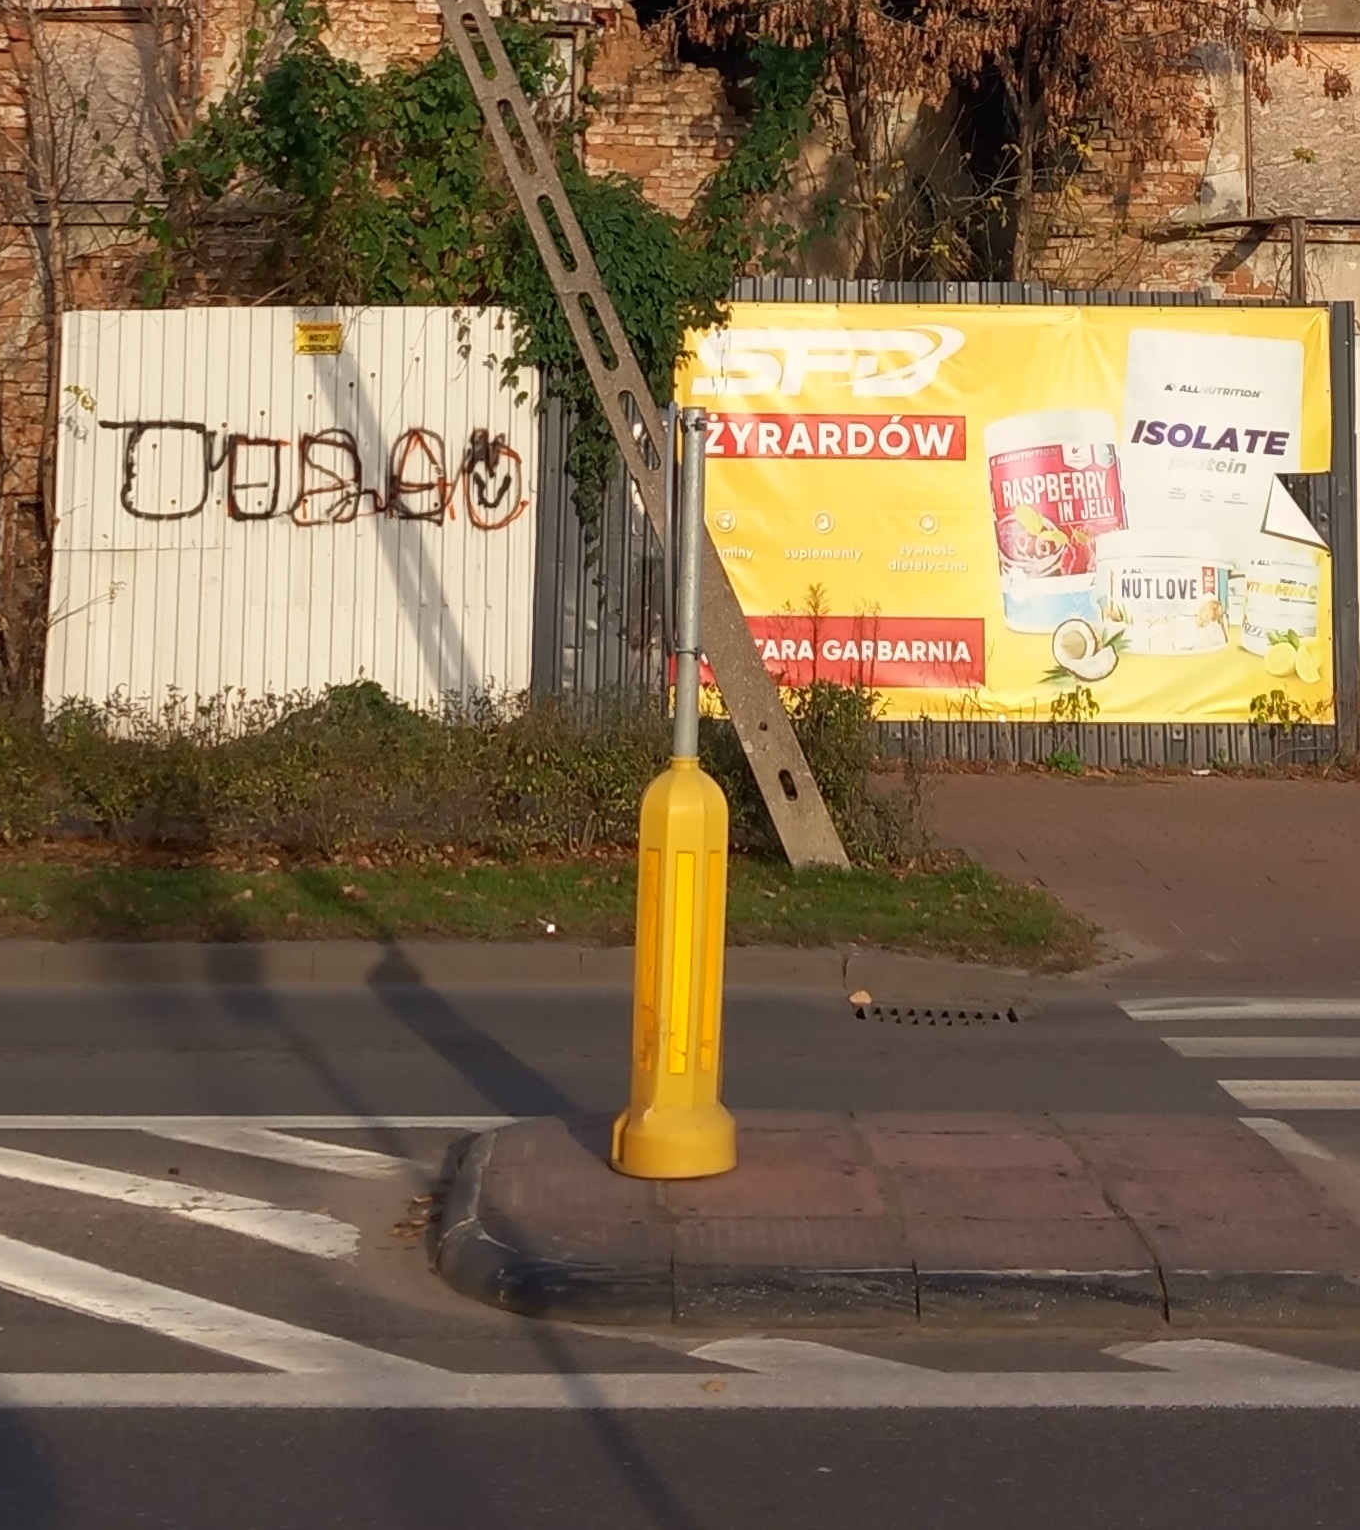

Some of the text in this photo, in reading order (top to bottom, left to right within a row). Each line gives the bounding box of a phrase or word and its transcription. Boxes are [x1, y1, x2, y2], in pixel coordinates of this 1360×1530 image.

[691, 323, 966, 398] SFD
[705, 414, 954, 457] ŻYRARDÓW
[1131, 419, 1290, 456] ISOLATE
[1002, 470, 1107, 509] RASPBERRY
[1058, 496, 1115, 523] IN JELLY
[784, 547, 863, 563] suplementy
[1121, 577, 1197, 599] NUTLOVE
[822, 639, 972, 662] GARBARNIA
